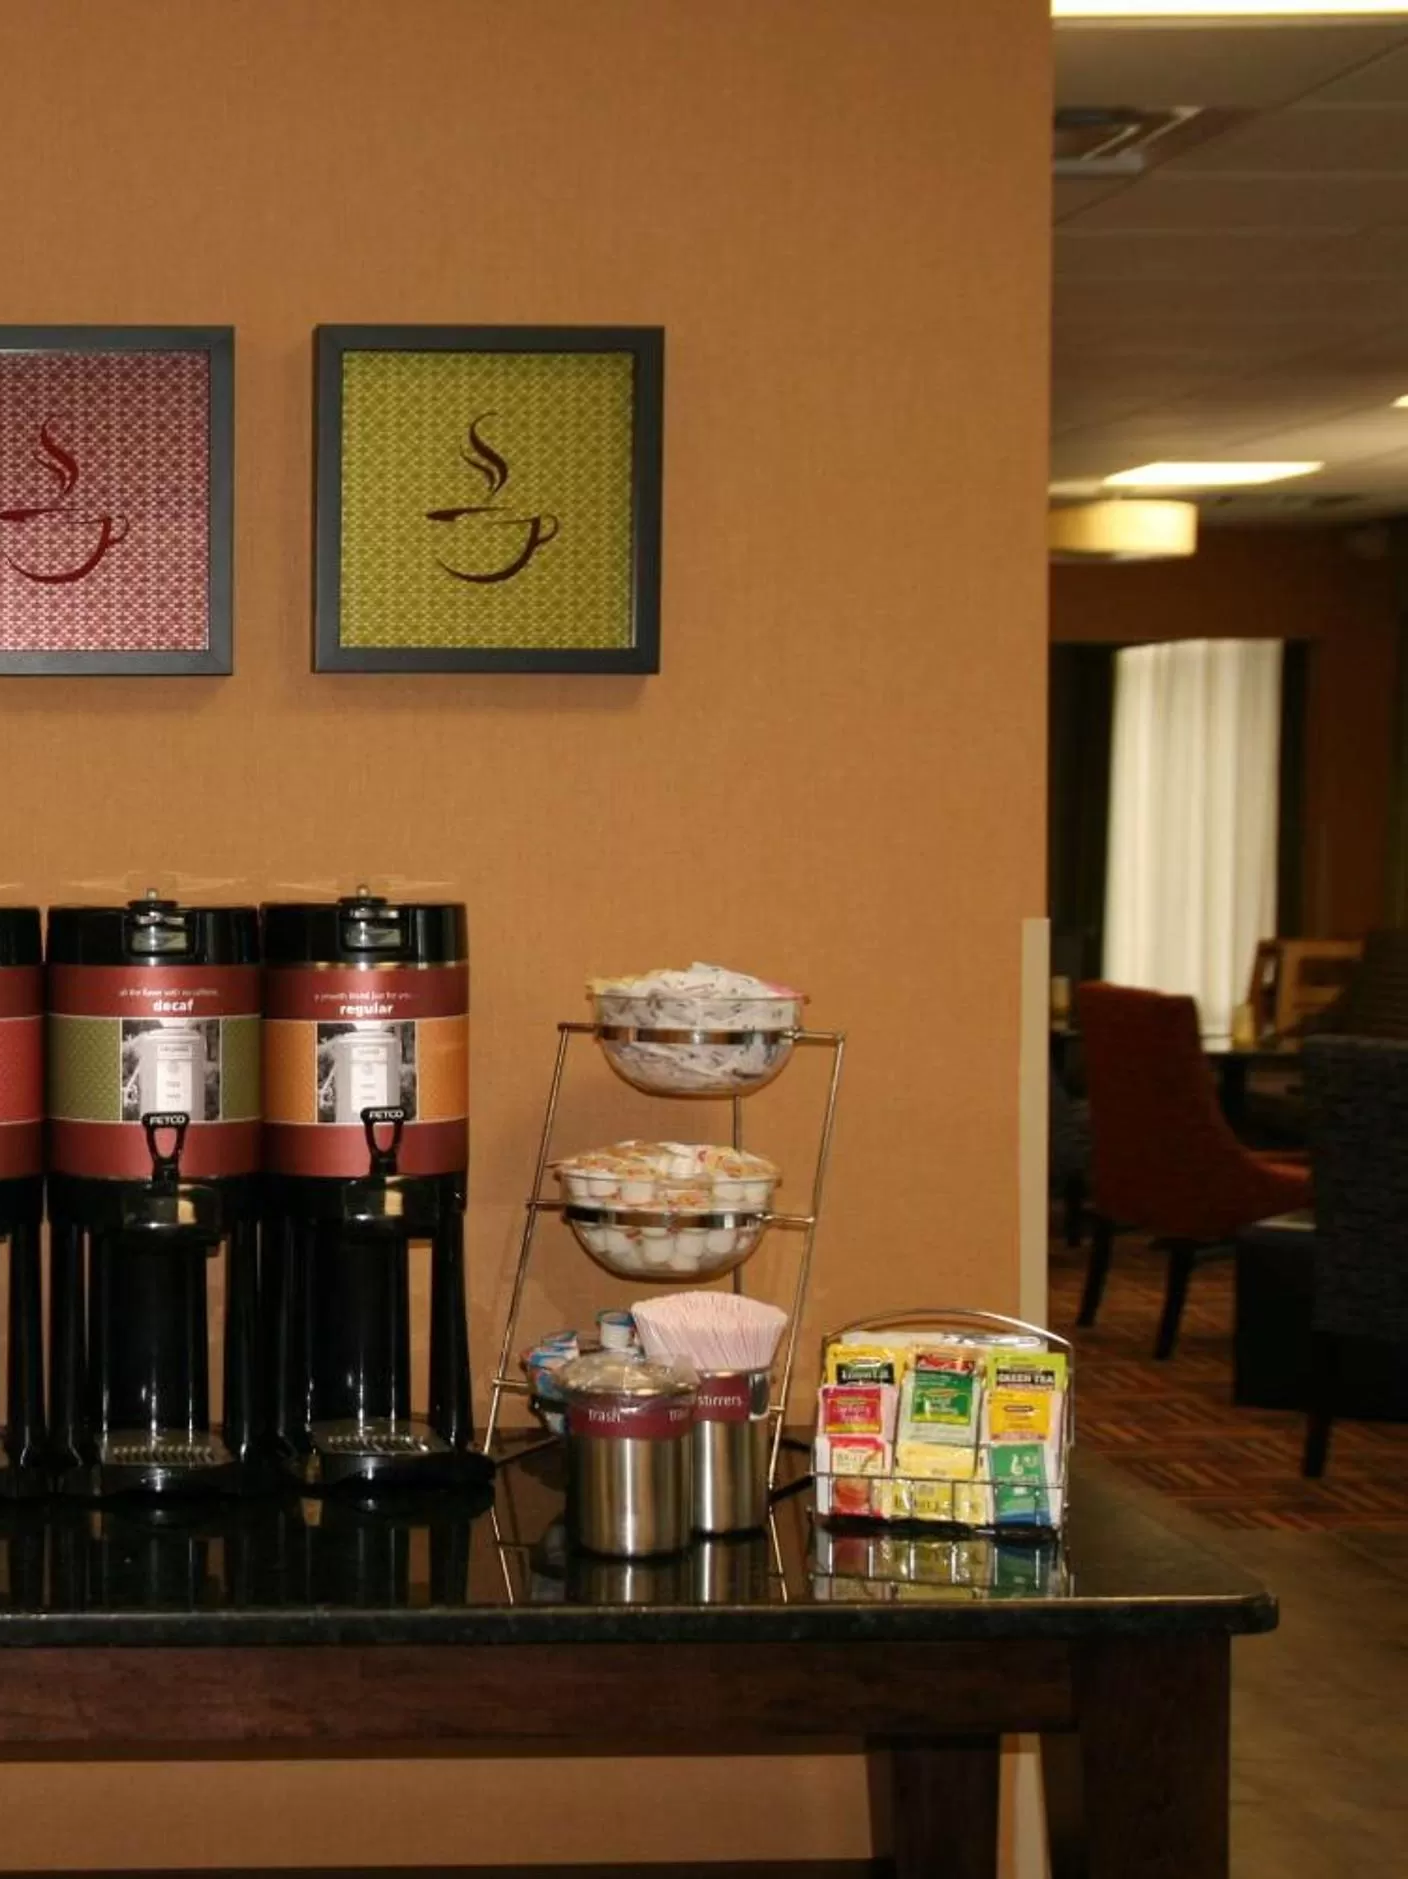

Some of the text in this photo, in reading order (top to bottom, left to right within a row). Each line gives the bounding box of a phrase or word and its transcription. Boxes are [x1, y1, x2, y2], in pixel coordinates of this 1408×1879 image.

[153, 999, 194, 1012] decaf
[339, 1002, 393, 1017] regular
[997, 1373, 1032, 1383] GREEN
[697, 1395, 742, 1407] stirrers
